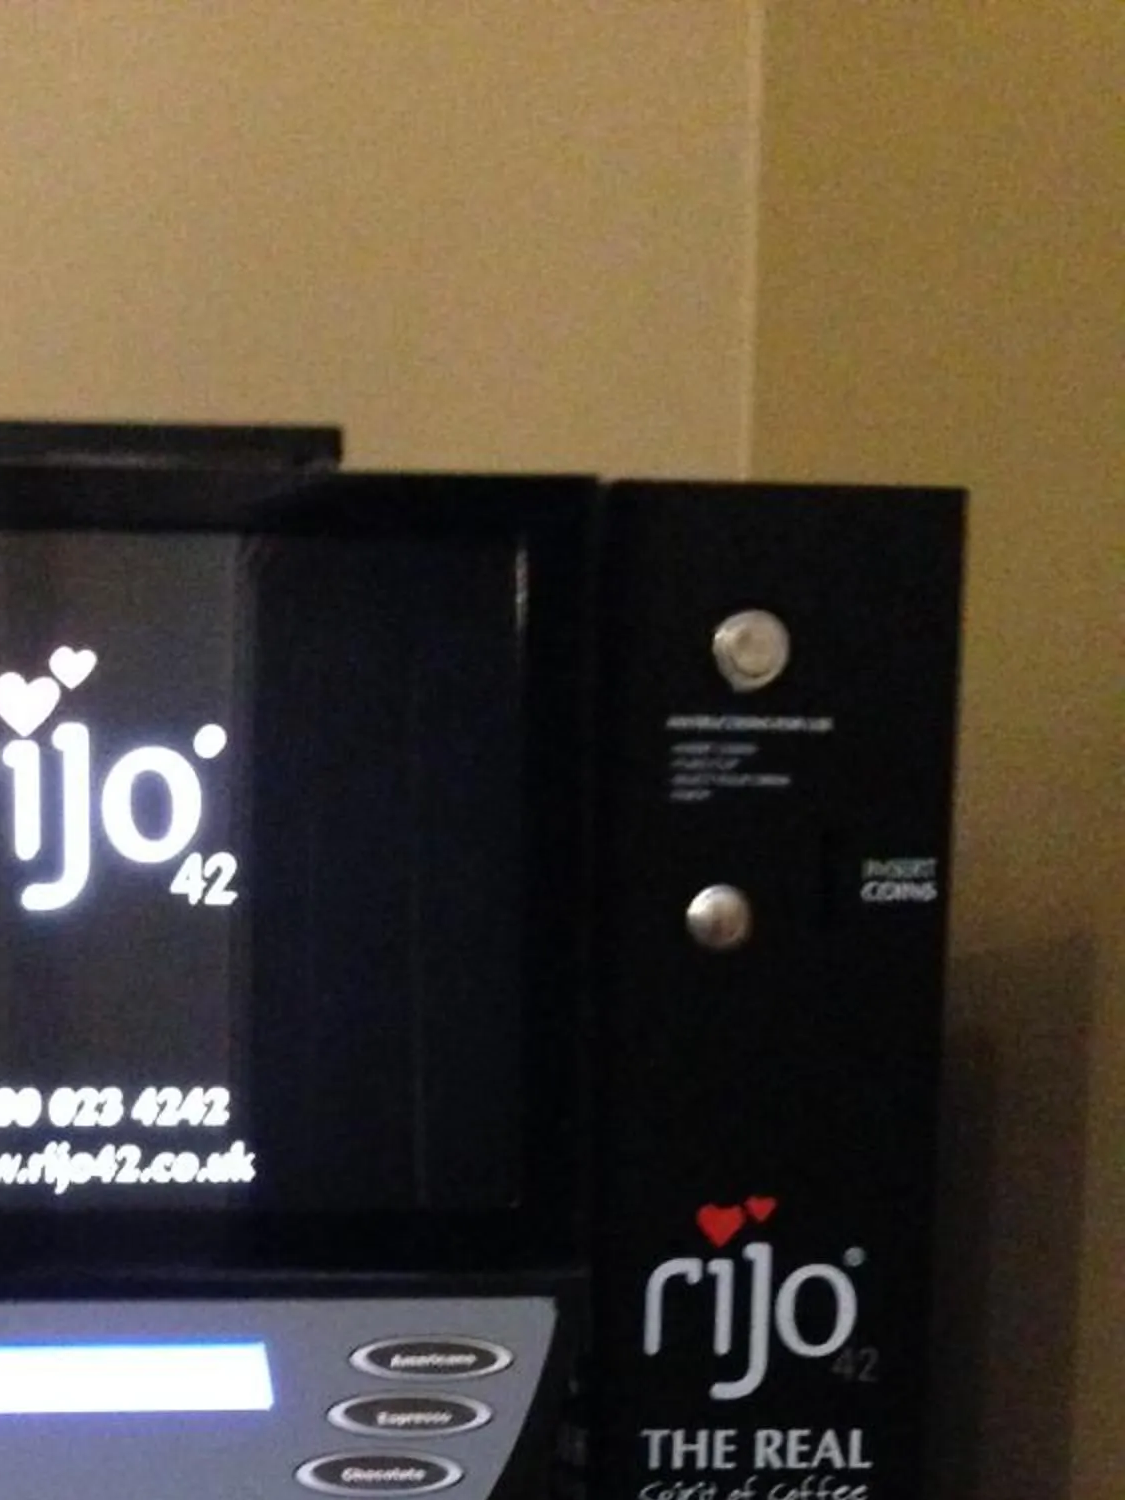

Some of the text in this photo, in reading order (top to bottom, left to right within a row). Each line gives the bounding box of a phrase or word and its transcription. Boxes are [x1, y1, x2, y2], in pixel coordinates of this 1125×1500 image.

[170, 852, 238, 905] 42
[48, 1086, 124, 1128] 023
[131, 1086, 231, 1128] 4242
[643, 1242, 858, 1400] rijo
[640, 1428, 873, 1470] THE REAL
